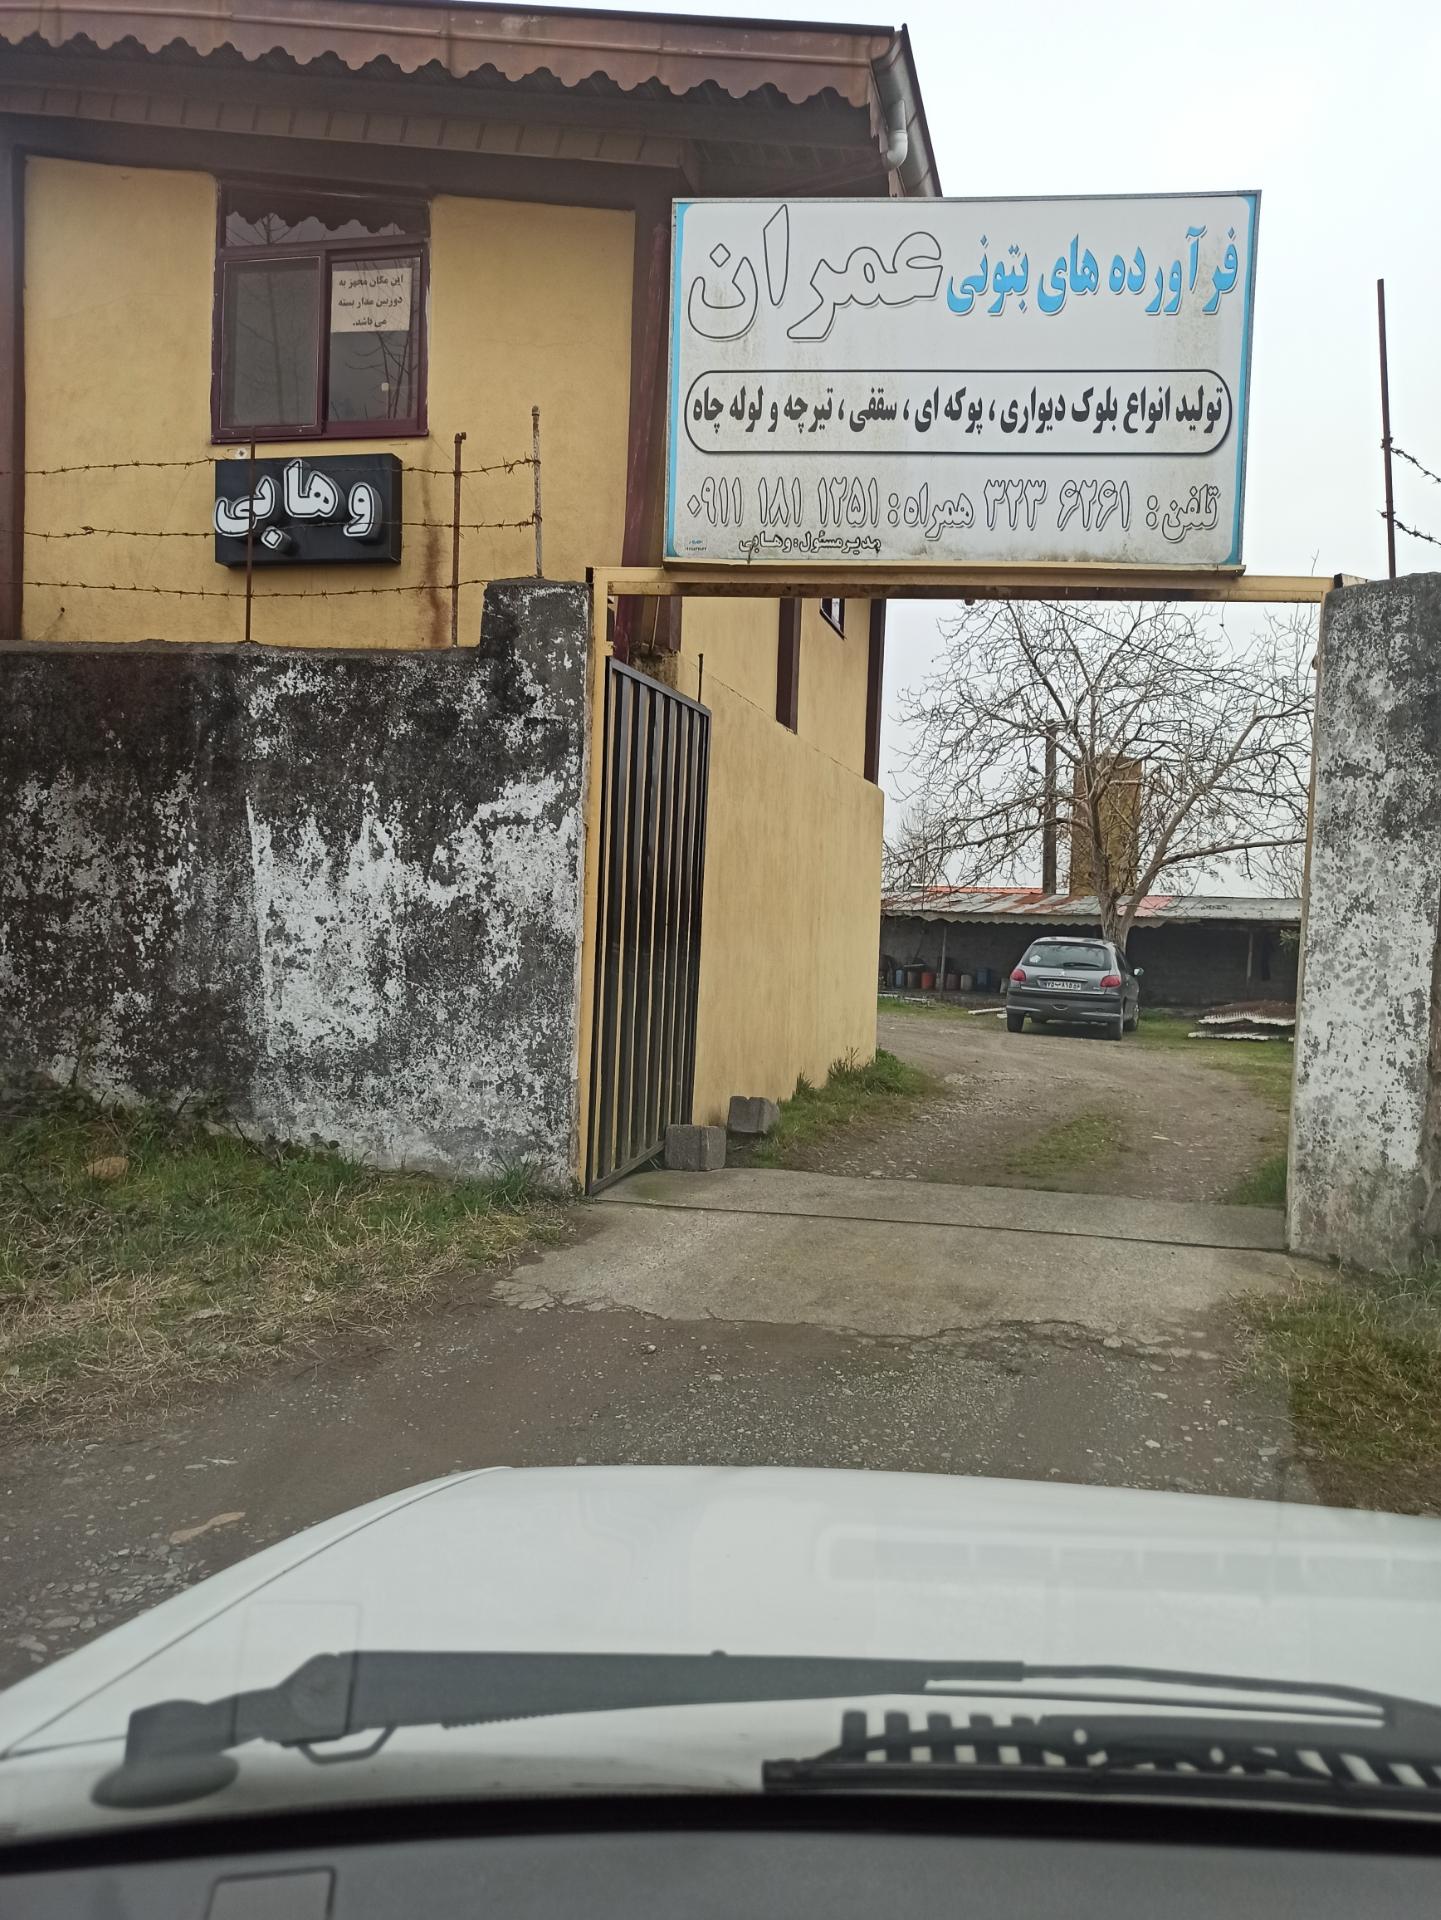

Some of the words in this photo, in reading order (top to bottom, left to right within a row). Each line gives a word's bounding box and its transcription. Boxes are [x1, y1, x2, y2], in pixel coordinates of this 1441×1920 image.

[339, 279, 347, 287] به
[369, 275, 389, 287] مکان
[391, 274, 404, 286] این
[687, 203, 944, 340] عمران
[946, 235, 1029, 314] بتونی
[1037, 233, 1100, 313] های
[338, 299, 355, 308] بسته
[357, 297, 374, 308] مدار
[693, 386, 724, 434] چاه
[729, 385, 764, 432] لوله
[767, 401, 778, 432] و
[783, 387, 833, 434] تیرچه
[1071, 386, 1118, 433] بلوک
[1123, 385, 1171, 433] انواع
[1176, 385, 1224, 434] تولید
[213, 459, 375, 549] وهابی
[757, 477, 802, 526] ۱۸۱
[817, 477, 880, 526] ۱۲۵۱
[888, 483, 974, 541] همراه:
[984, 479, 1047, 530] ۳۲۳
[1057, 479, 1130, 530] ۶۲۶۱
[1146, 483, 1219, 542] تلفن:
[739, 531, 792, 553] وهابی
[841, 536, 881, 555] مدیر
